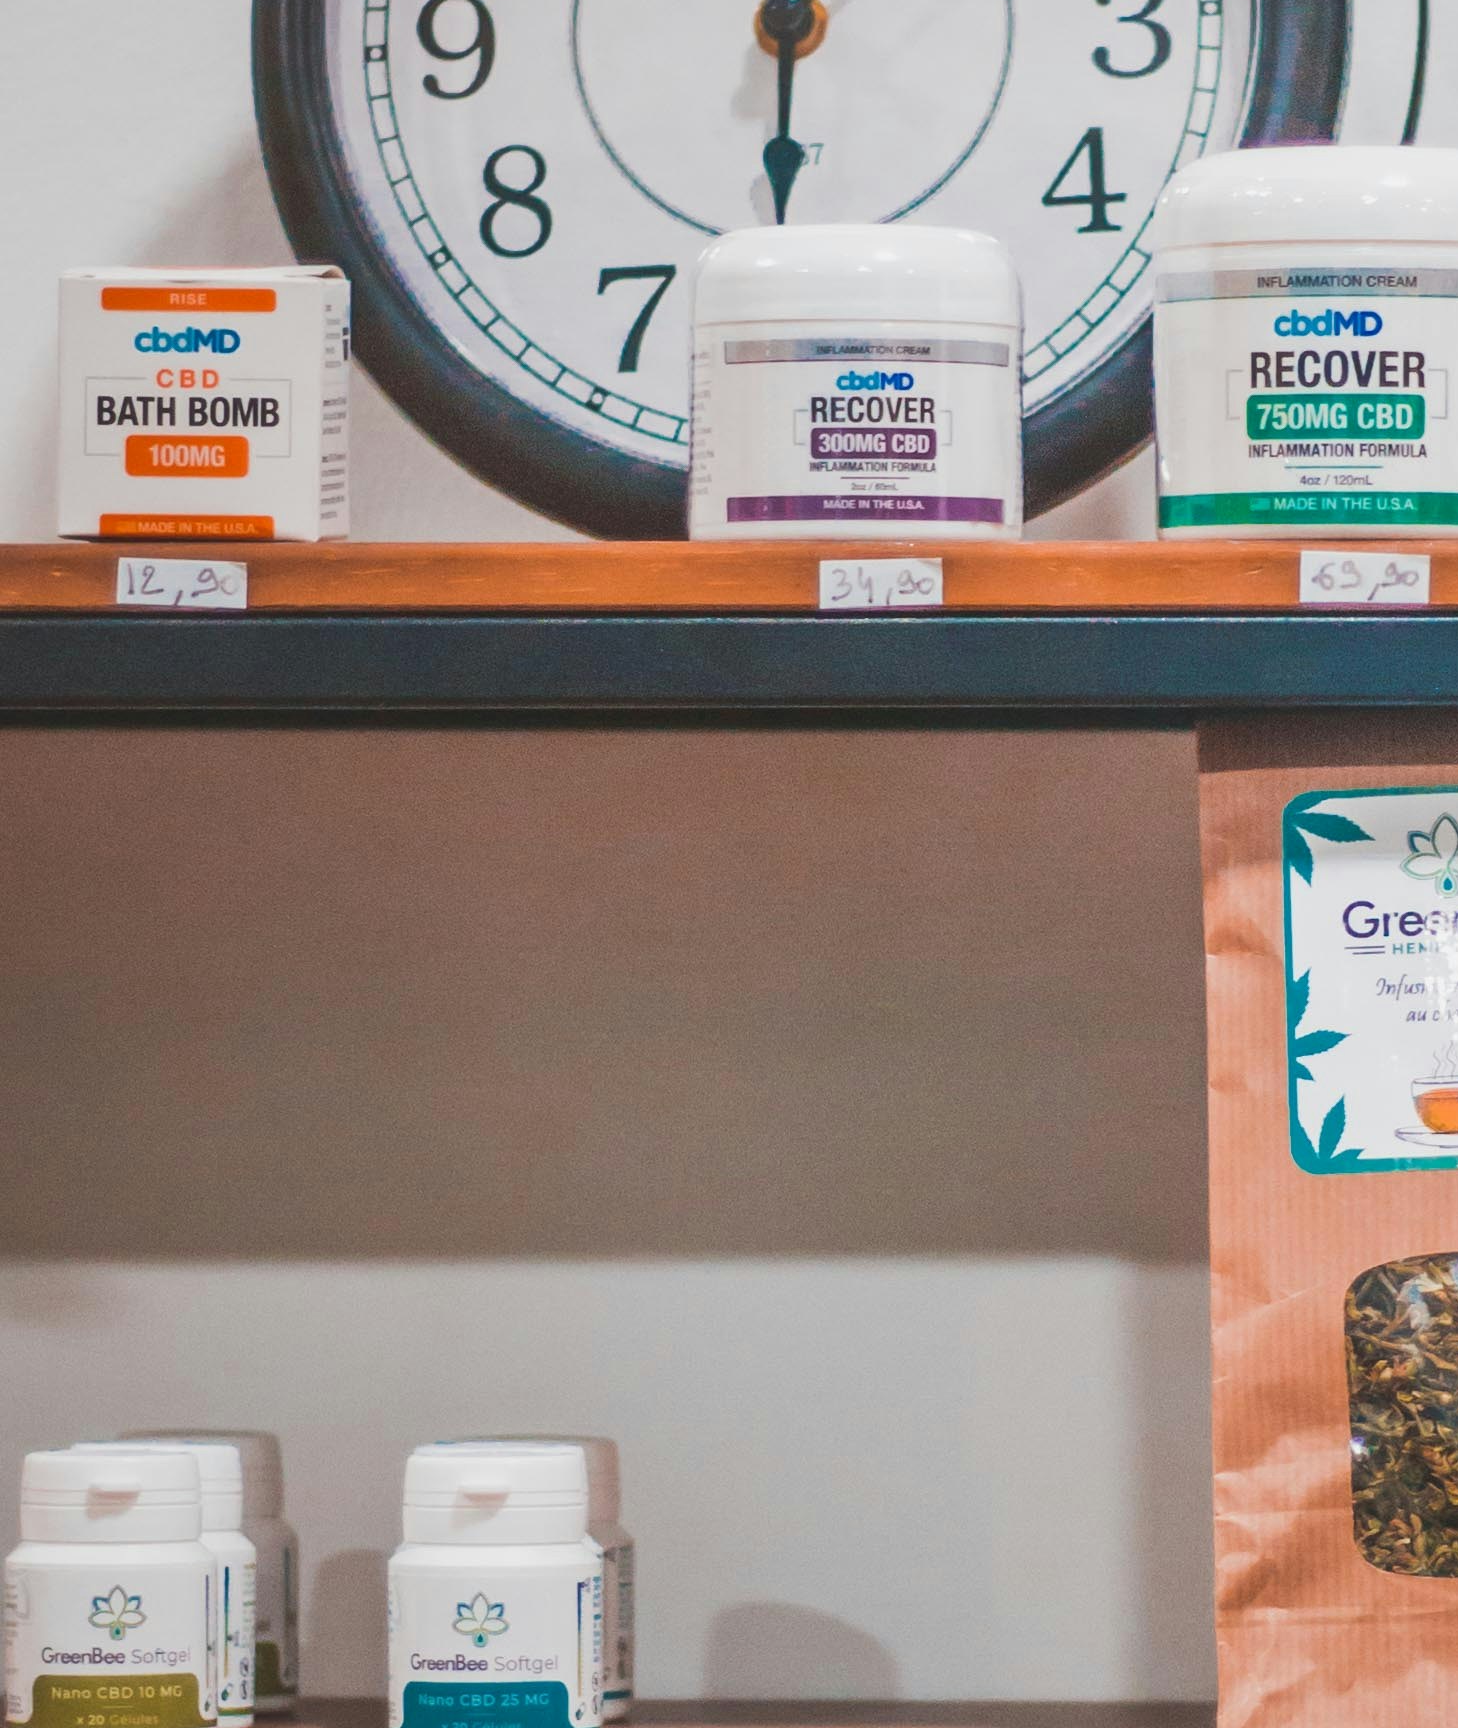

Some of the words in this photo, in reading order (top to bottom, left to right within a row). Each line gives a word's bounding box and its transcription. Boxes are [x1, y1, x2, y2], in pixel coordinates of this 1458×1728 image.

[1041, 127, 1127, 233] 4
[479, 144, 553, 258] 8
[1257, 275, 1362, 288] INFLAMMATION
[1366, 275, 1417, 287] CREAM
[169, 293, 207, 305] RISE
[596, 265, 677, 374] 7
[1274, 309, 1383, 337] cbdMD
[134, 327, 240, 354] cbdMD
[817, 346, 893, 354] INFLAMMATION
[896, 346, 931, 355] CREAM
[156, 369, 219, 388] CBD
[1250, 350, 1425, 388] RECOVER
[836, 370, 914, 391] cbdMD
[97, 396, 176, 426] BATH
[189, 397, 279, 427] BOMB
[811, 397, 935, 423] RECOVER
[1257, 404, 1347, 430] 750MG
[1357, 404, 1413, 429] CBD
[819, 433, 886, 453] 300MG
[892, 435, 929, 453] CBD
[1248, 443, 1354, 458] INFLAMMATION
[1359, 444, 1427, 458] FORMULA
[150, 444, 225, 467] 100MG
[810, 462, 887, 472] INFLAMMATION
[892, 462, 936, 472] FORMULA
[1300, 475, 1320, 485] 4oz
[823, 499, 856, 509] MADE
[859, 500, 869, 509] IN
[872, 500, 894, 509] THE
[1274, 497, 1317, 510] MADE
[1322, 497, 1337, 510] IN
[1342, 497, 1372, 510] THE
[138, 522, 175, 533] MADE
[179, 522, 191, 533] IN
[197, 522, 220, 533] THE
[42, 1647, 125, 1664] GreenBee
[131, 1648, 191, 1666] Softgel
[411, 1654, 488, 1671] GreenBee
[495, 1655, 558, 1673] Softgel
[52, 1687, 91, 1700] Nano
[97, 1687, 133, 1699] CBD
[139, 1687, 155, 1698] 10
[160, 1686, 182, 1697] MG
[419, 1694, 454, 1706] Nano
[460, 1694, 495, 1706] CBD
[501, 1694, 519, 1706] 25
[525, 1694, 549, 1705] MG
